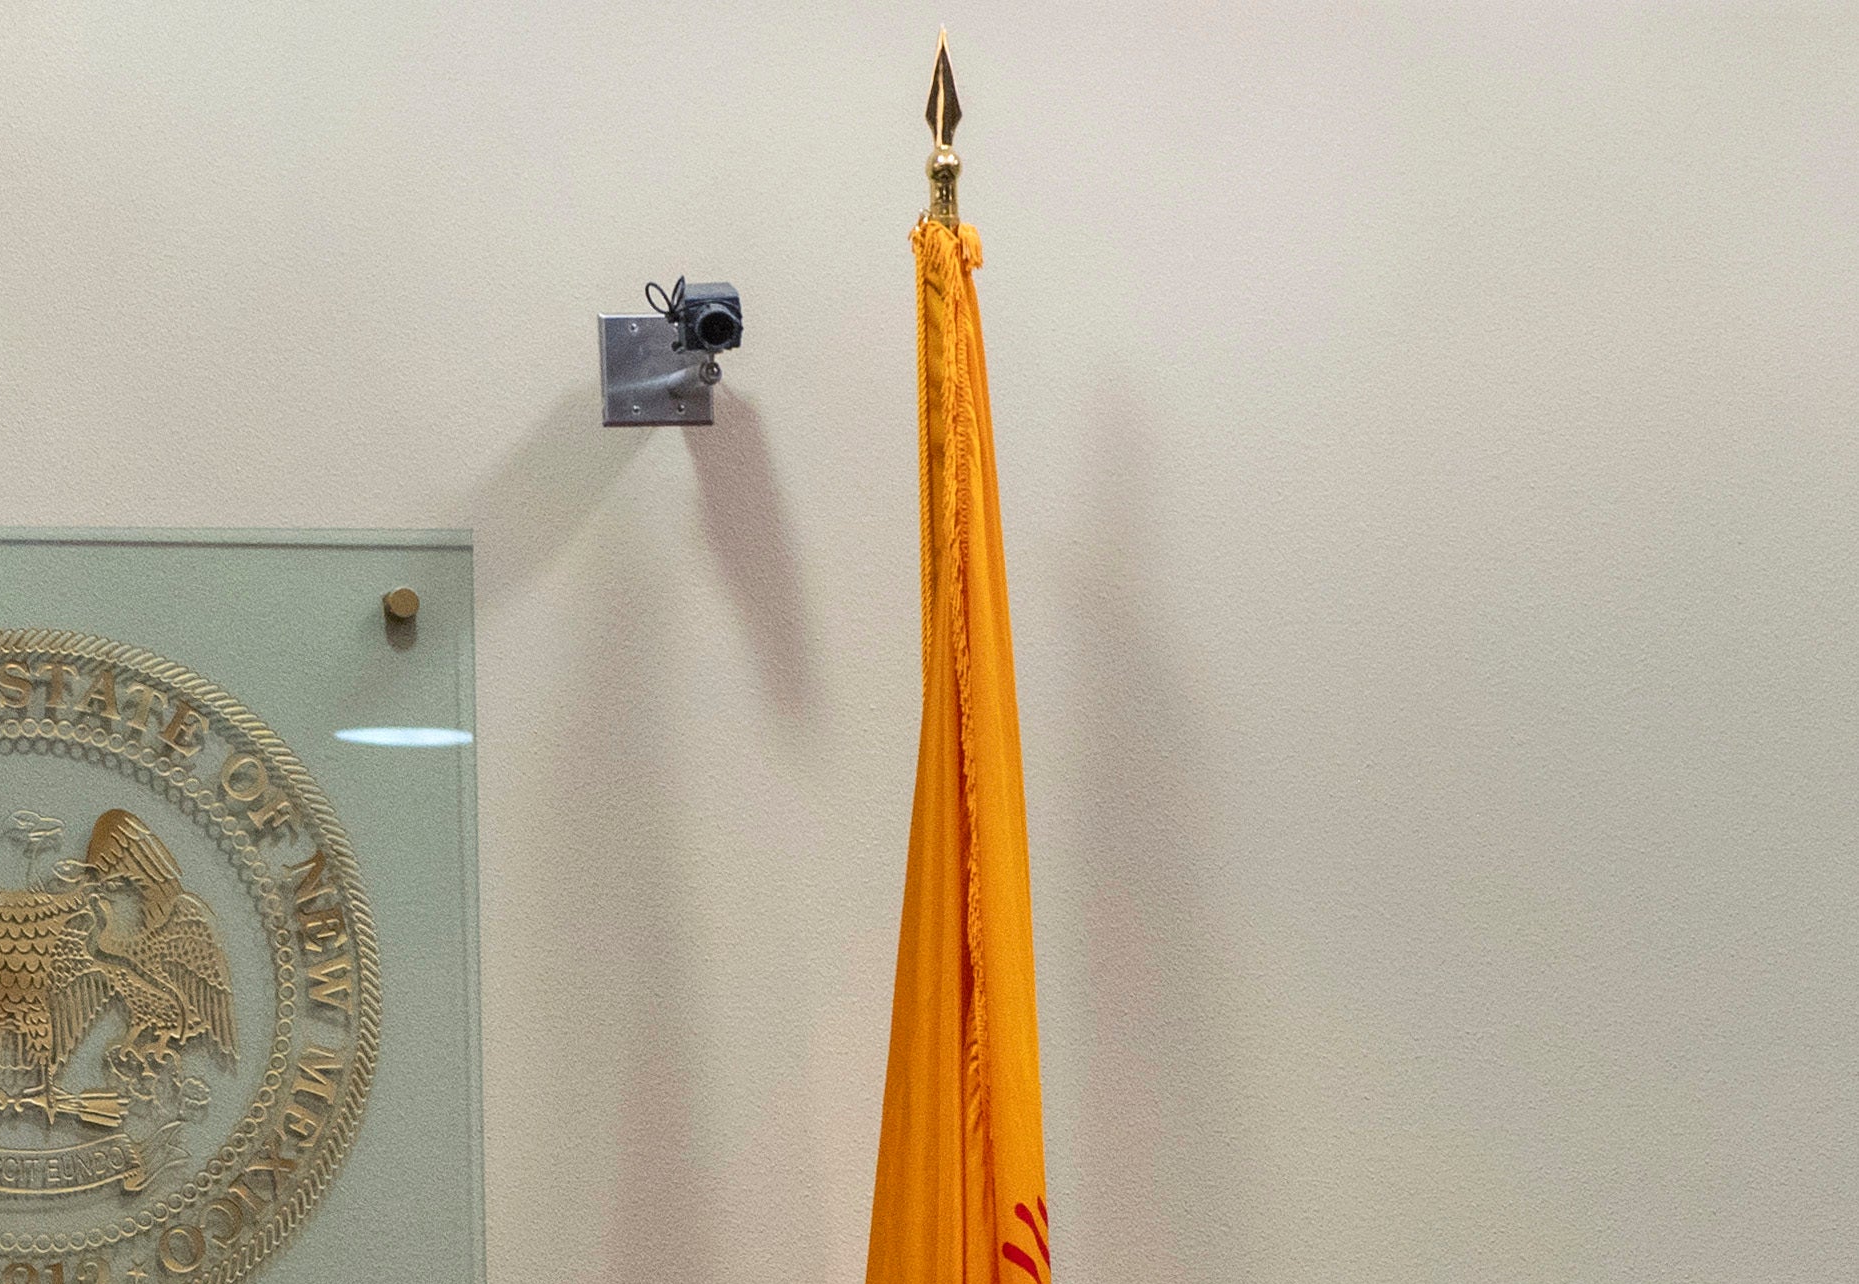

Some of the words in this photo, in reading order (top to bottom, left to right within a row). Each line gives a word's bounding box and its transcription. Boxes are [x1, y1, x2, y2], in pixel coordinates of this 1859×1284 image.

[221, 754, 295, 829] OF
[282, 850, 352, 1014] NEW
[47, 1146, 125, 1183] EUNDO
[158, 1041, 343, 1273] MEXICO
